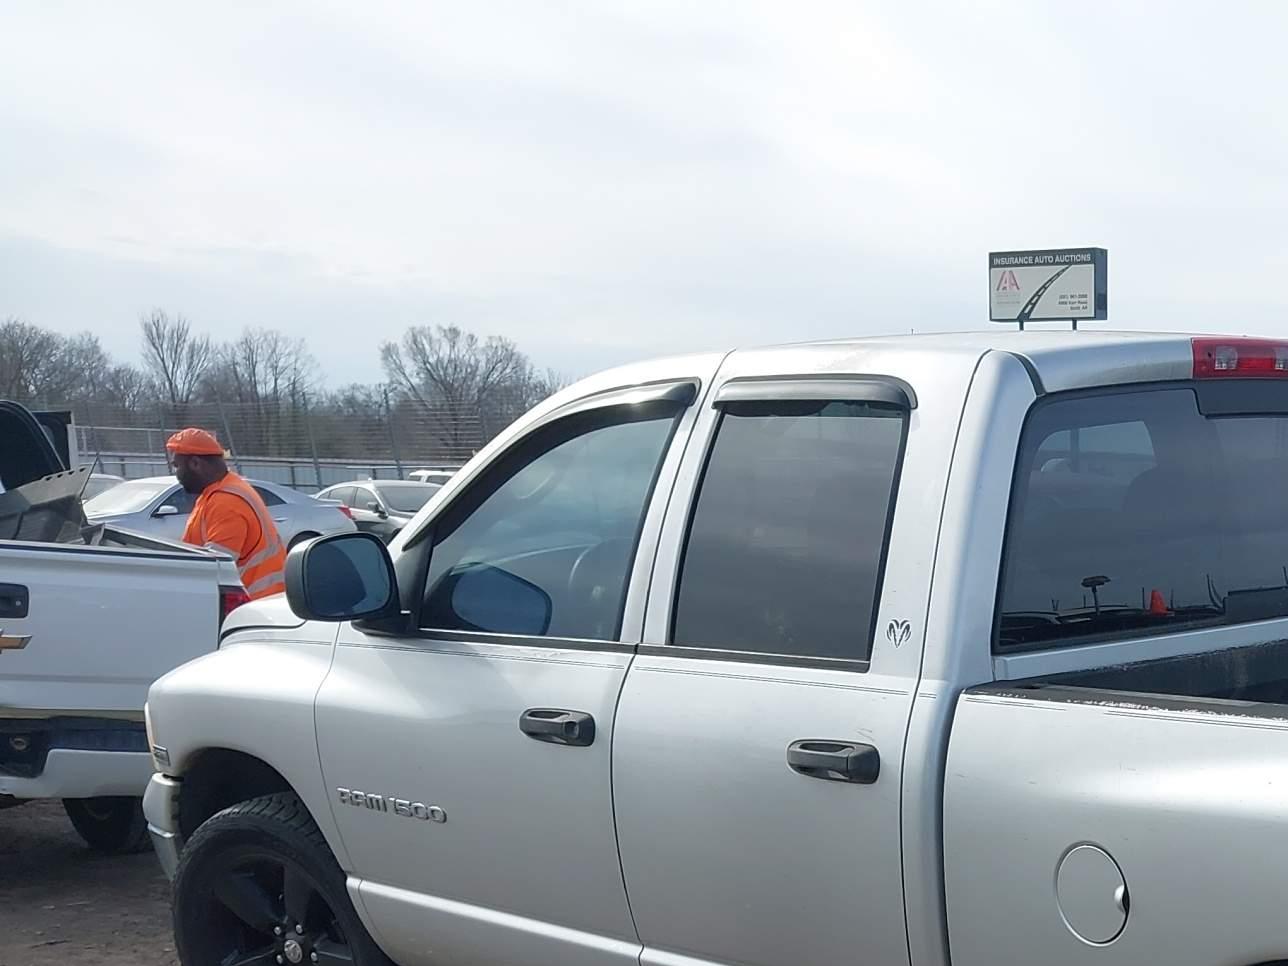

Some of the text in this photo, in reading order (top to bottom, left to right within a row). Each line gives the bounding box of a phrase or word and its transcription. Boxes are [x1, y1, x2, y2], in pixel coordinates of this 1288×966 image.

[993, 253, 1091, 265] INSURANCE AUTO AUCTIONS
[388, 796, 448, 824] 1500
